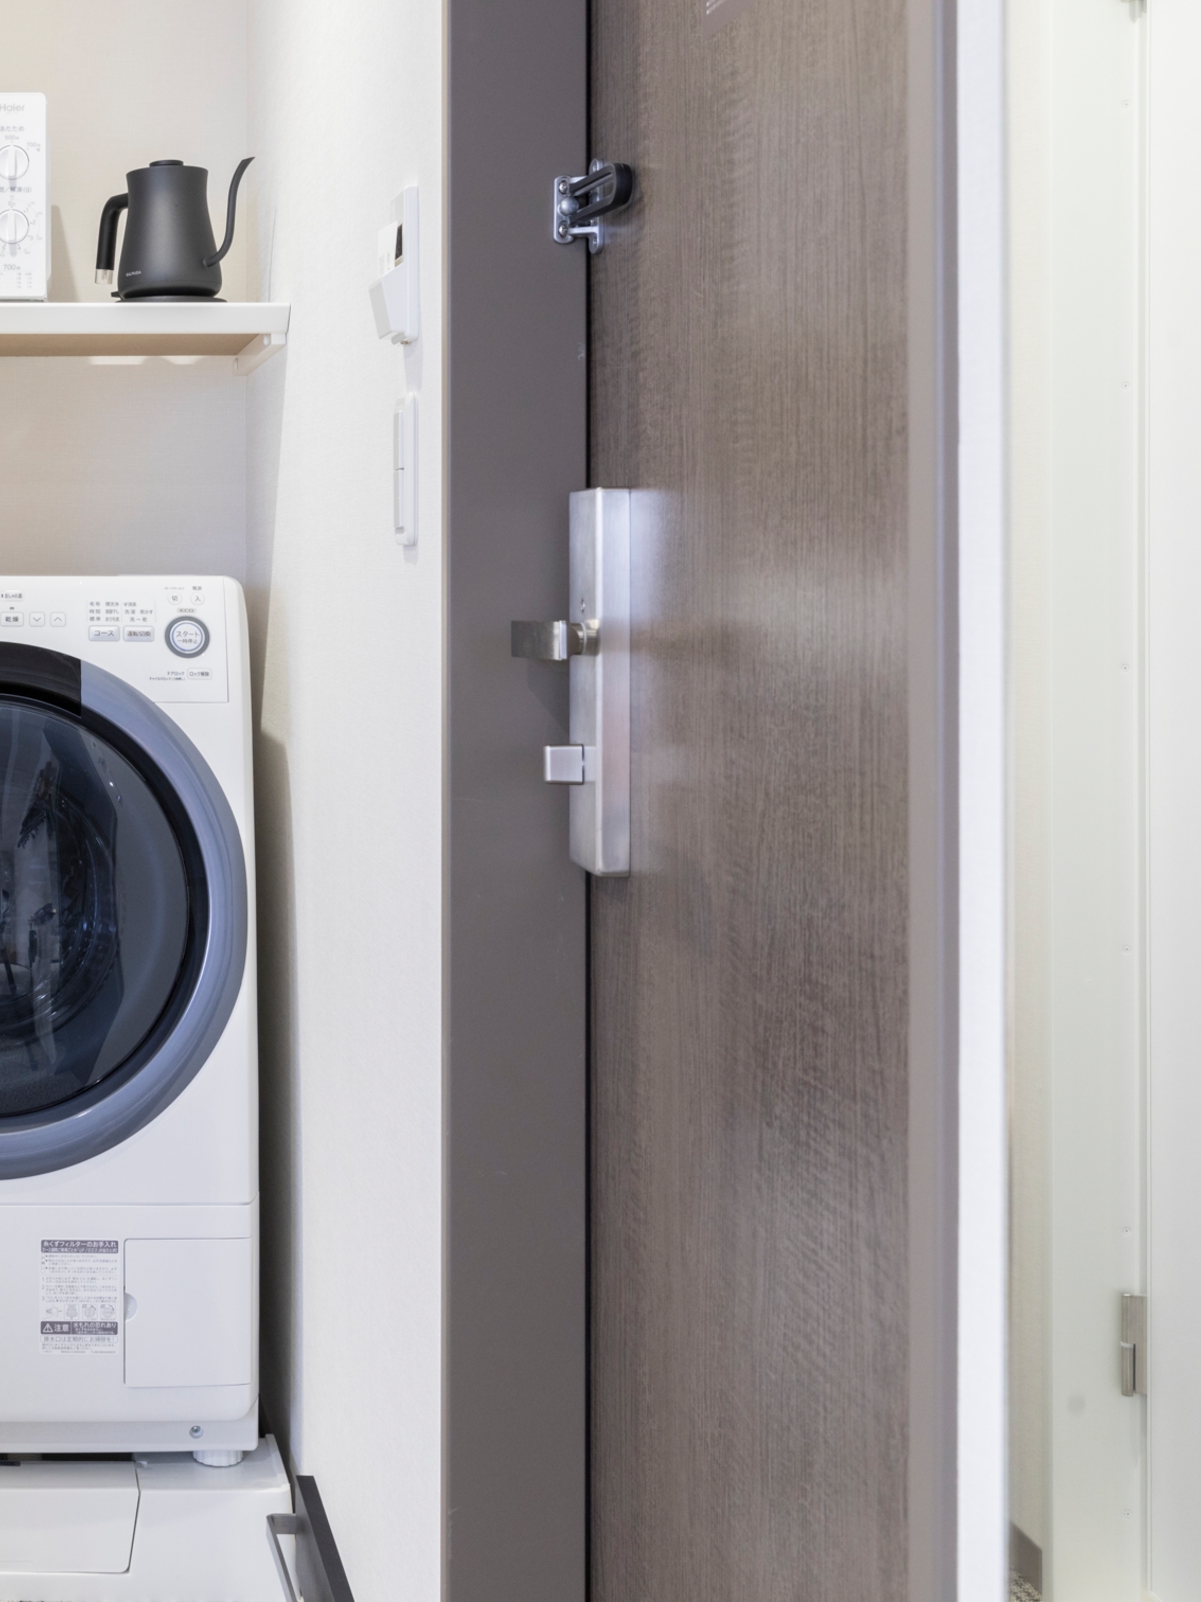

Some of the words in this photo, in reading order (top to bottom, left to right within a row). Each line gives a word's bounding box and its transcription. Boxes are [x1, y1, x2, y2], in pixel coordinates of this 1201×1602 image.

[194, 595, 202, 603] 入
[4, 615, 20, 623] 乾燥
[176, 630, 200, 638] スタート
[54, 1323, 70, 1333] 注意
